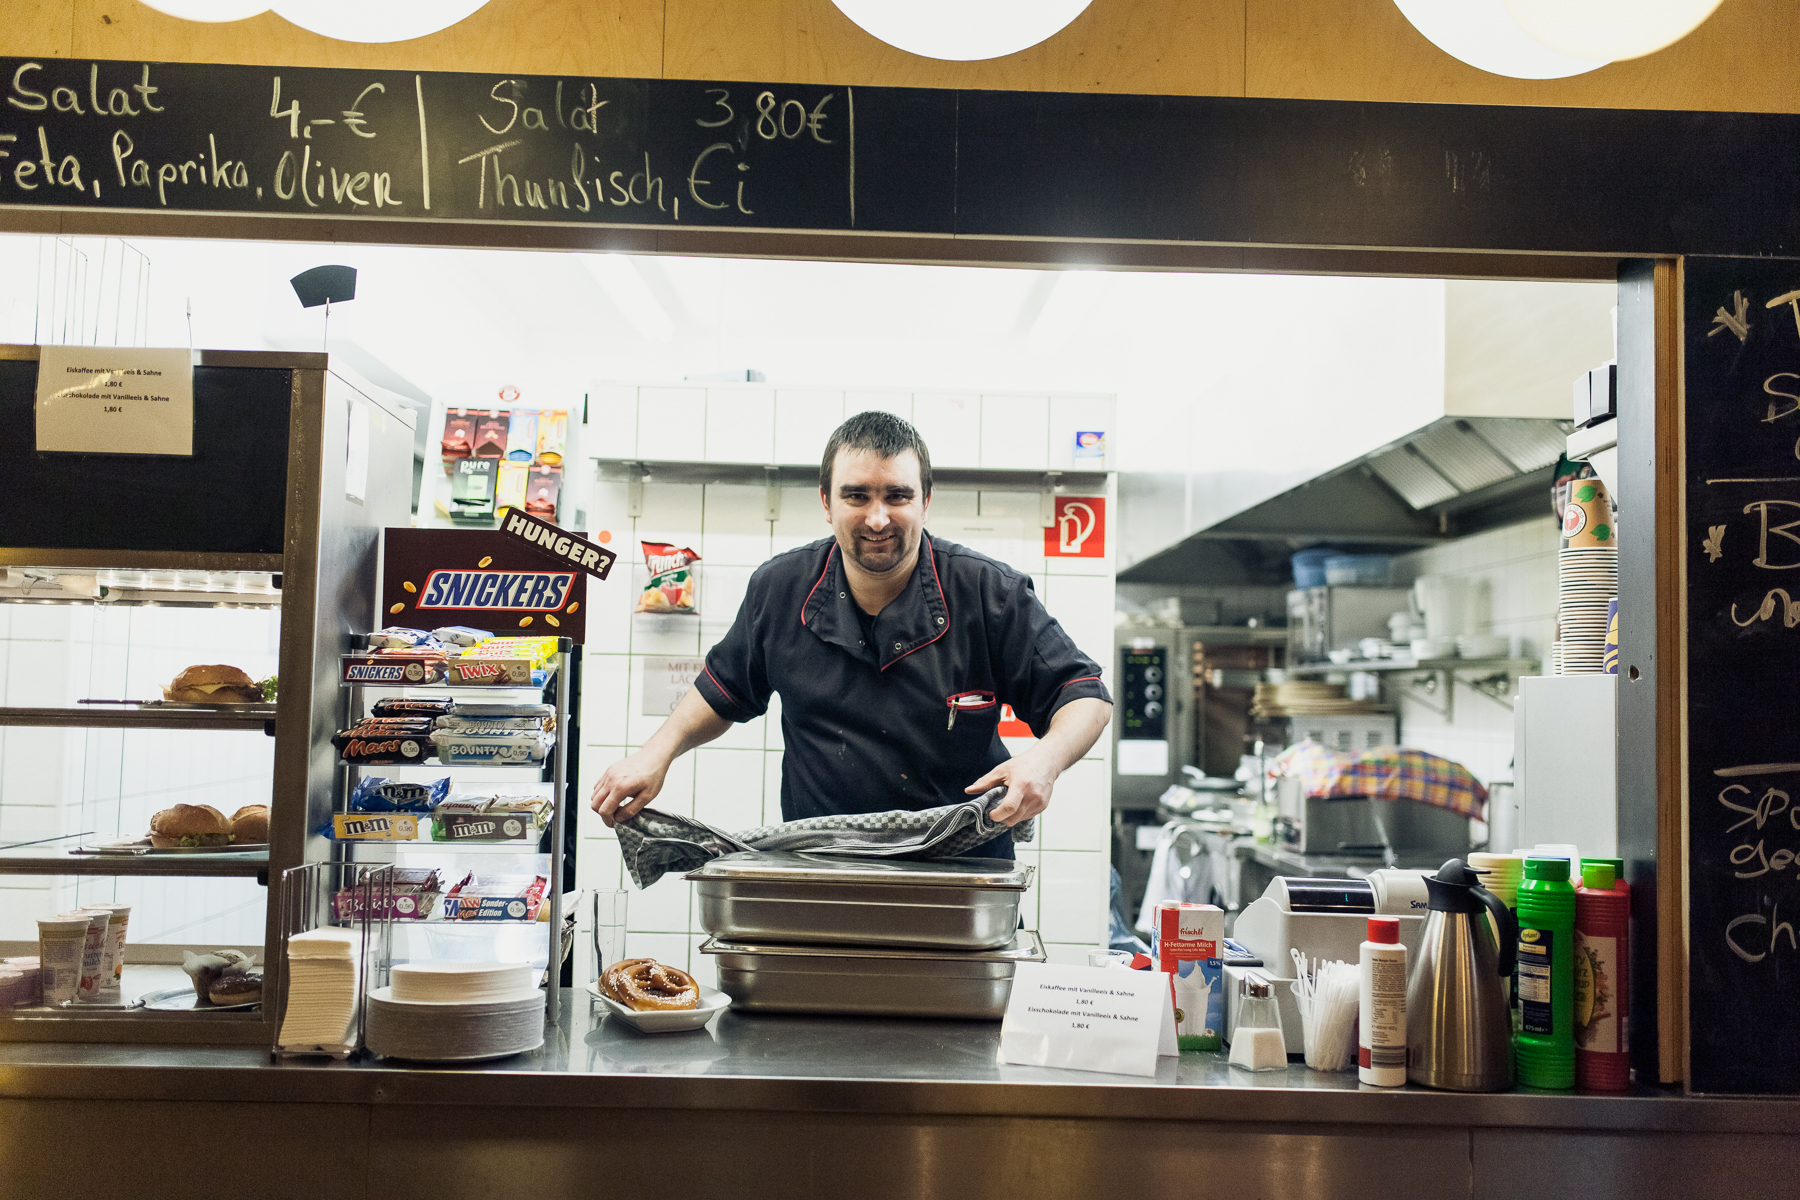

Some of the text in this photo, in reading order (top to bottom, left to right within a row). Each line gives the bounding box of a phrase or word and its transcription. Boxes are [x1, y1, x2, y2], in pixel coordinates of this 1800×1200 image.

[7, 63, 165, 115] Salat
[478, 80, 611, 135] Salat
[274, 144, 403, 208] Oliven
[104, 405, 117, 413] 1,80
[506, 514, 611, 573] HUNGER?
[426, 573, 570, 609] SNICKERS
[348, 666, 403, 679] SNICKERS
[407, 669, 423, 677] 0,90
[456, 662, 499, 680] Twix
[511, 670, 526, 678] 0,90
[342, 738, 400, 758] Mars
[451, 745, 498, 756] BOUNTY
[506, 824, 520, 832] 0,90
[479, 908, 502, 917] Edition
[1040, 983, 1066, 991] Eiskaffee
[1079, 986, 1108, 995] Vanilleeis
[1027, 1006, 1070, 1015] Eisschokolade
[1082, 1011, 1111, 1019] Vanilleeis
[1119, 1014, 1139, 1022] Sahne
